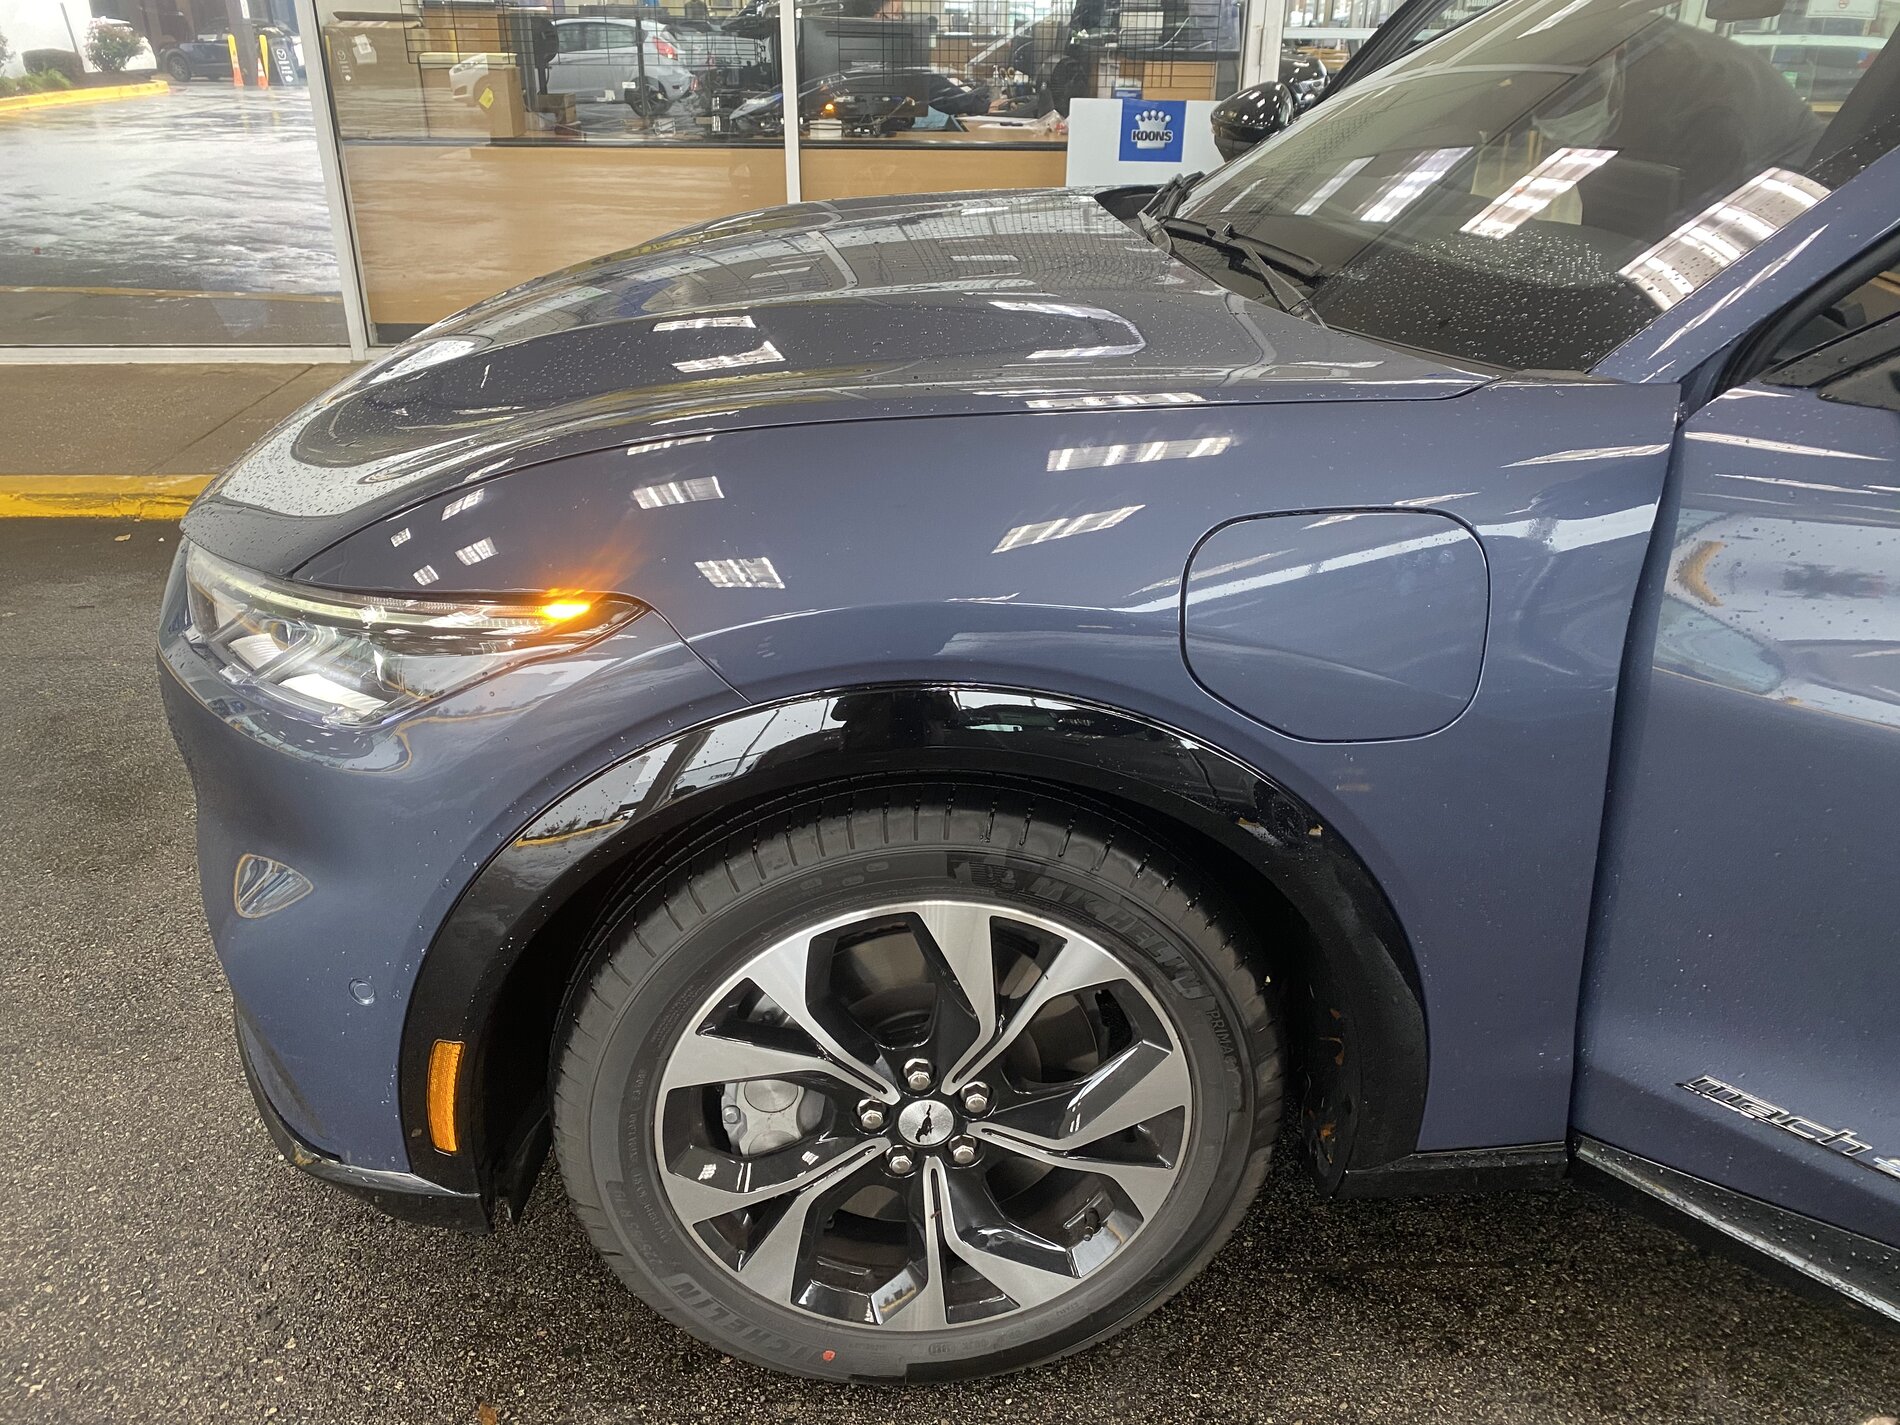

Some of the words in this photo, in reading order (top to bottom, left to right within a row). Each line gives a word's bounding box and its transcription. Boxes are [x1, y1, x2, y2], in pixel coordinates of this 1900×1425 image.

[1132, 130, 1172, 142] KOONS
[1032, 875, 1206, 993] MICHELIN
[1206, 1009, 1239, 1075] PRIMACY
